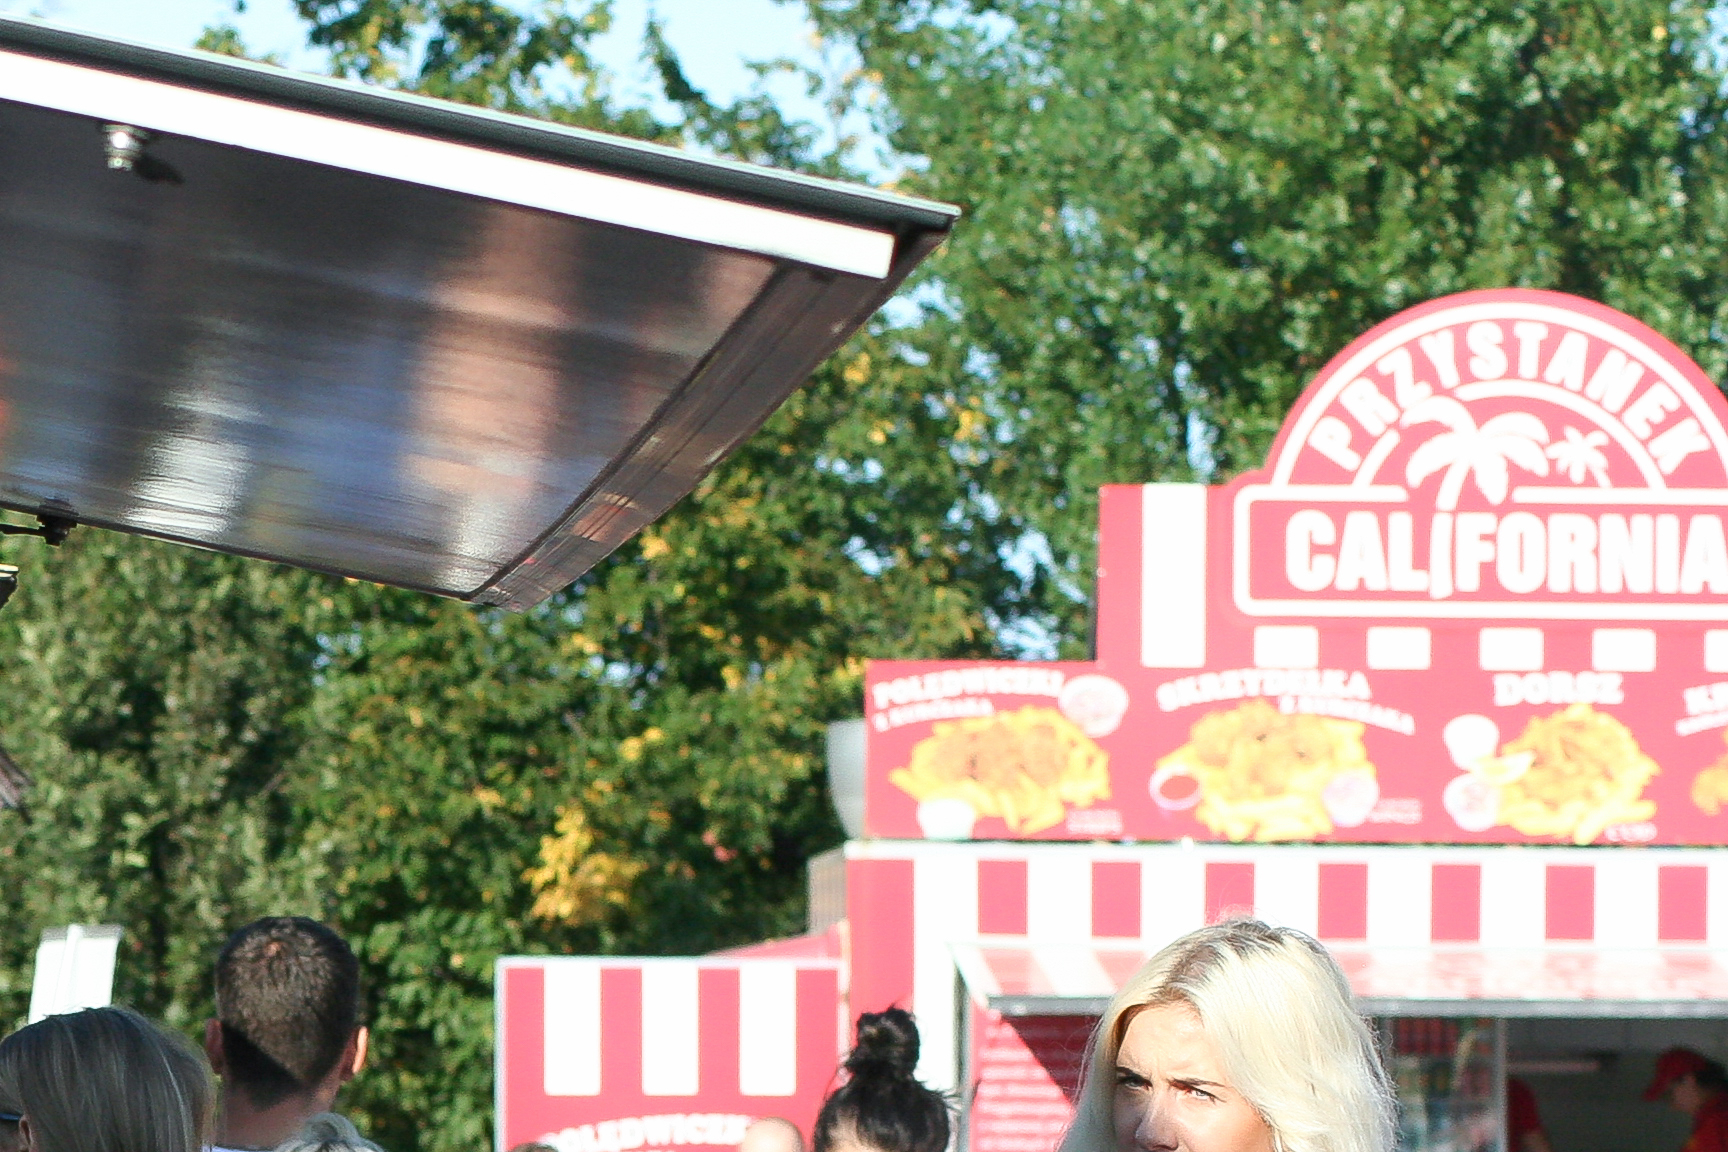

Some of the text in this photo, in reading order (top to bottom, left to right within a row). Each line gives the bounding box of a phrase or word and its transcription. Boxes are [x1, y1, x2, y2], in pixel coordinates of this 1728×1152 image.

[1309, 320, 1711, 476] PRZYSTANEK
[1285, 508, 1728, 598] CALIFORNIA
[1493, 671, 1624, 706] DORSZ
